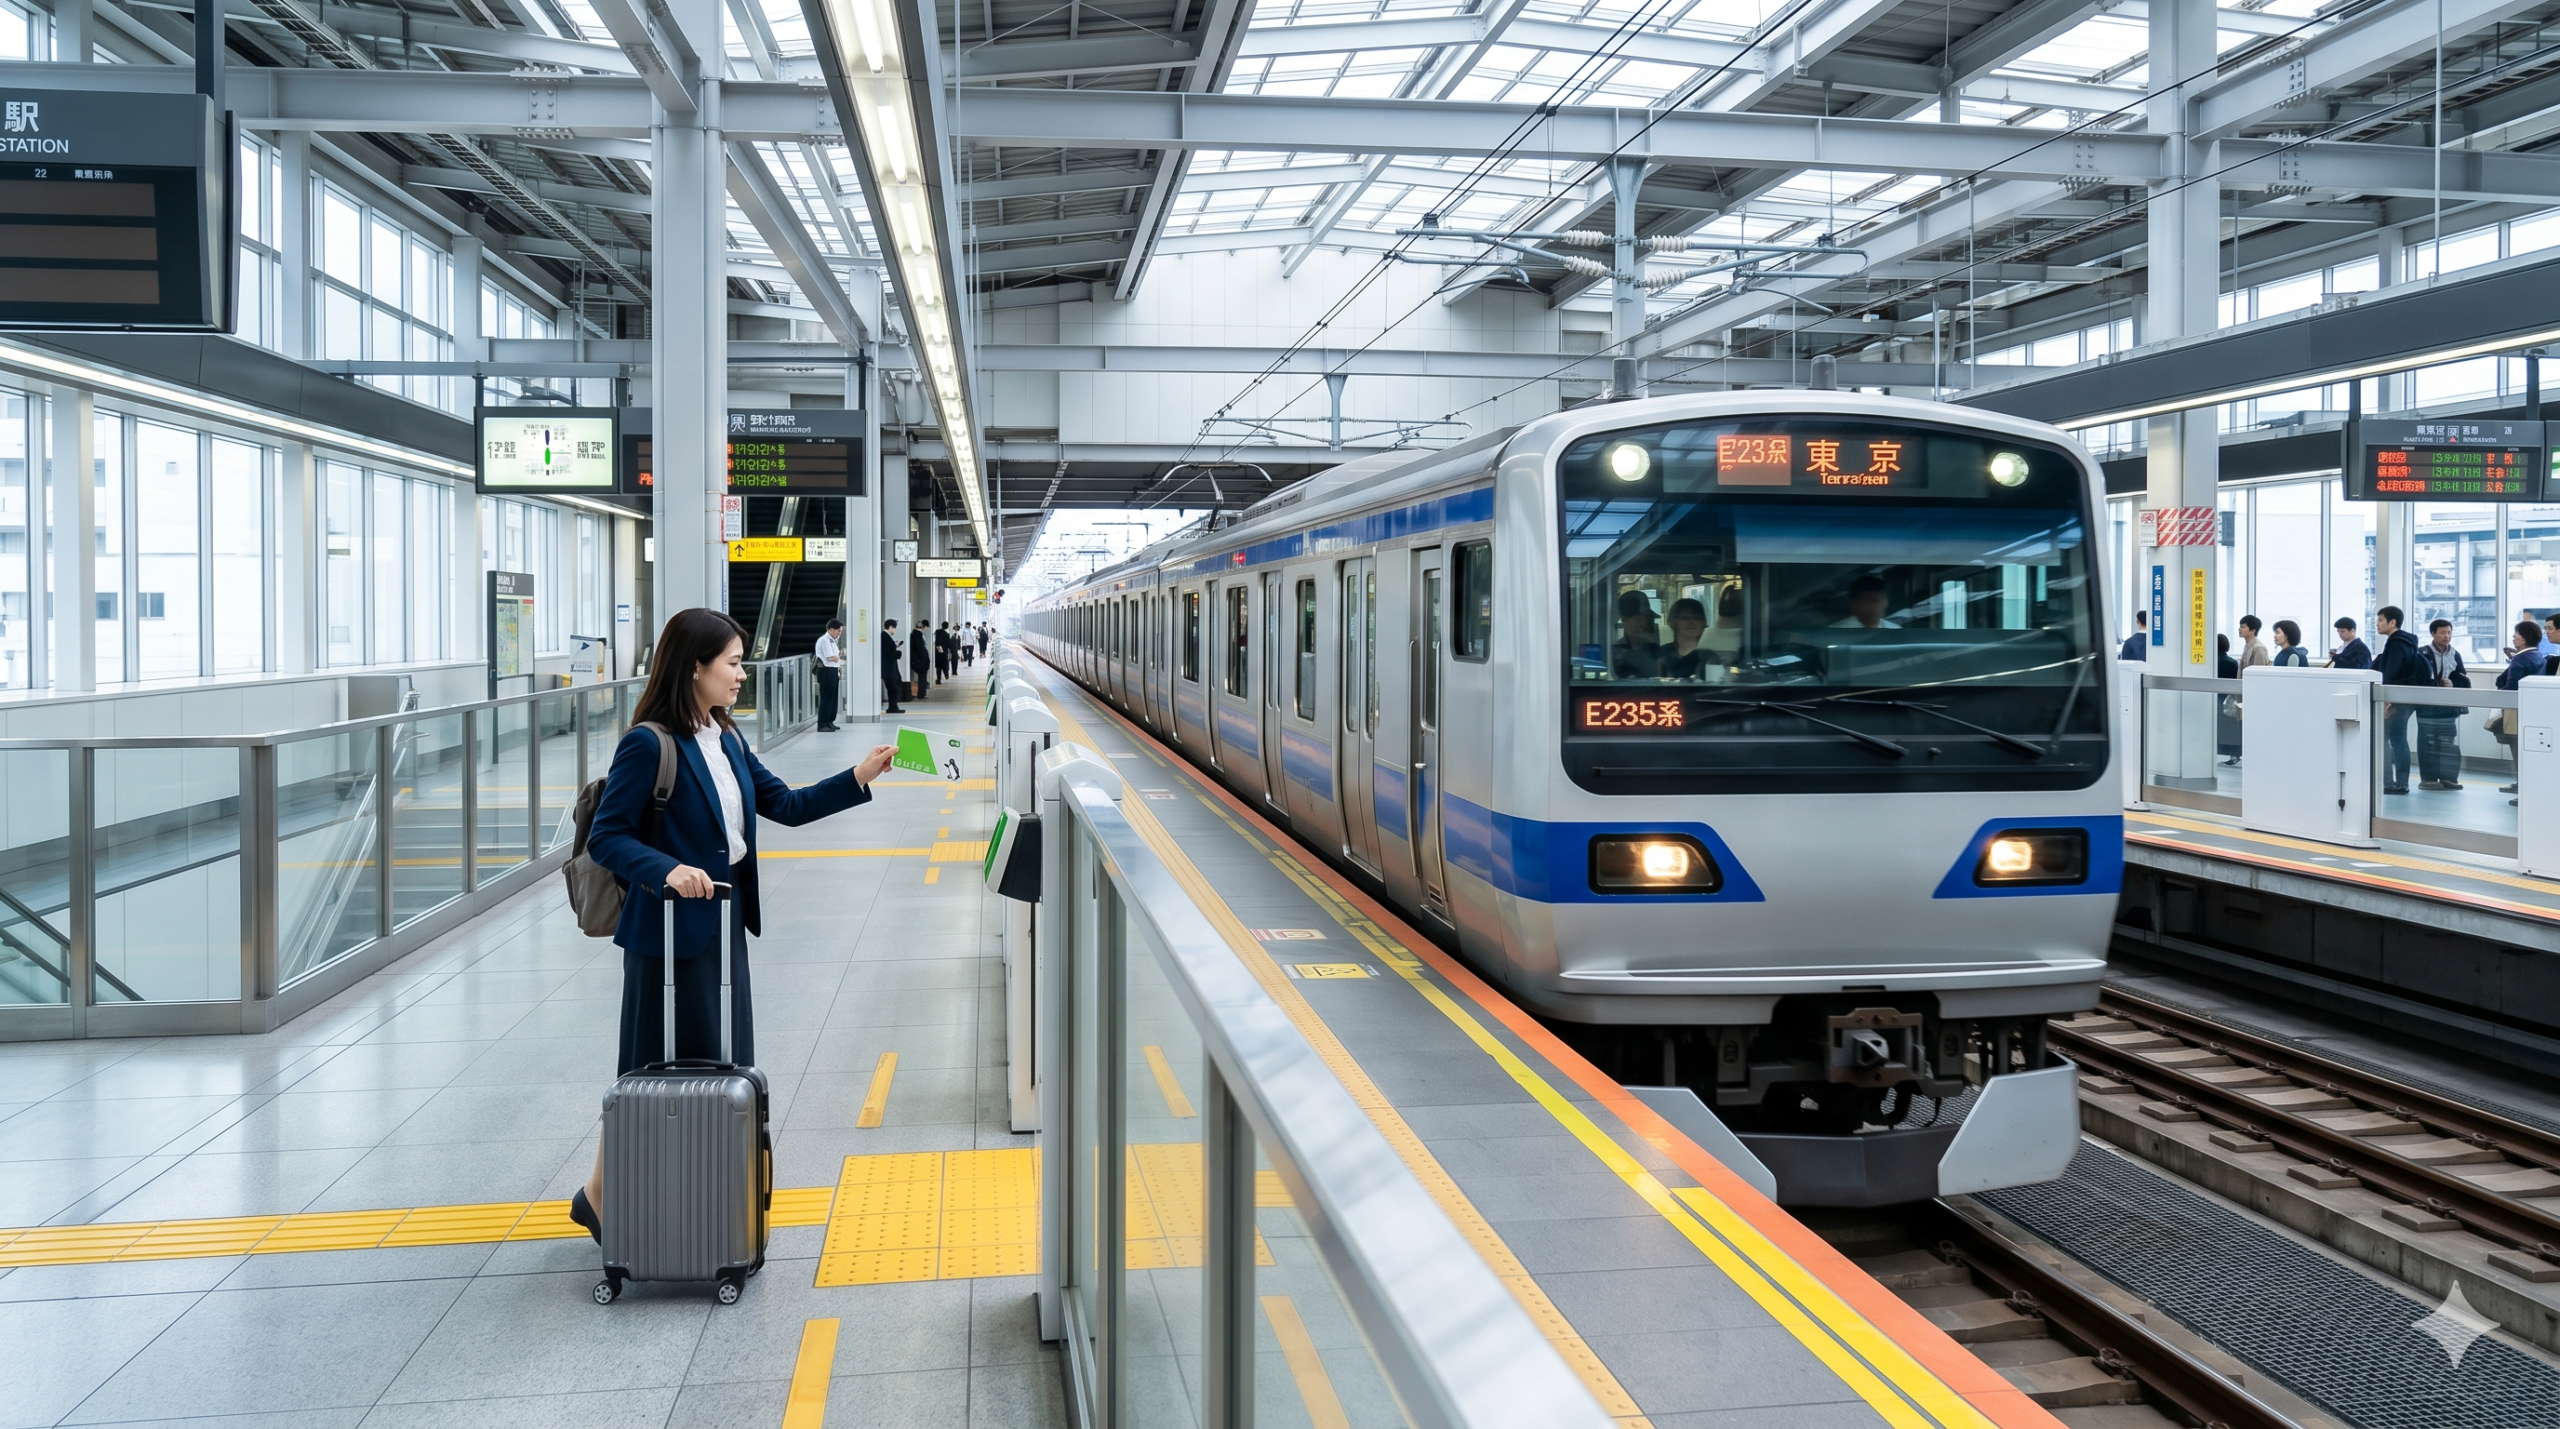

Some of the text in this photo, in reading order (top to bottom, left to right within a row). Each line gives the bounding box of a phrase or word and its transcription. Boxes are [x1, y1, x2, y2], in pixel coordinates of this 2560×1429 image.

[5, 101, 39, 132] 駅
[34, 168, 47, 178] 22
[1586, 701, 1682, 726] E235系
